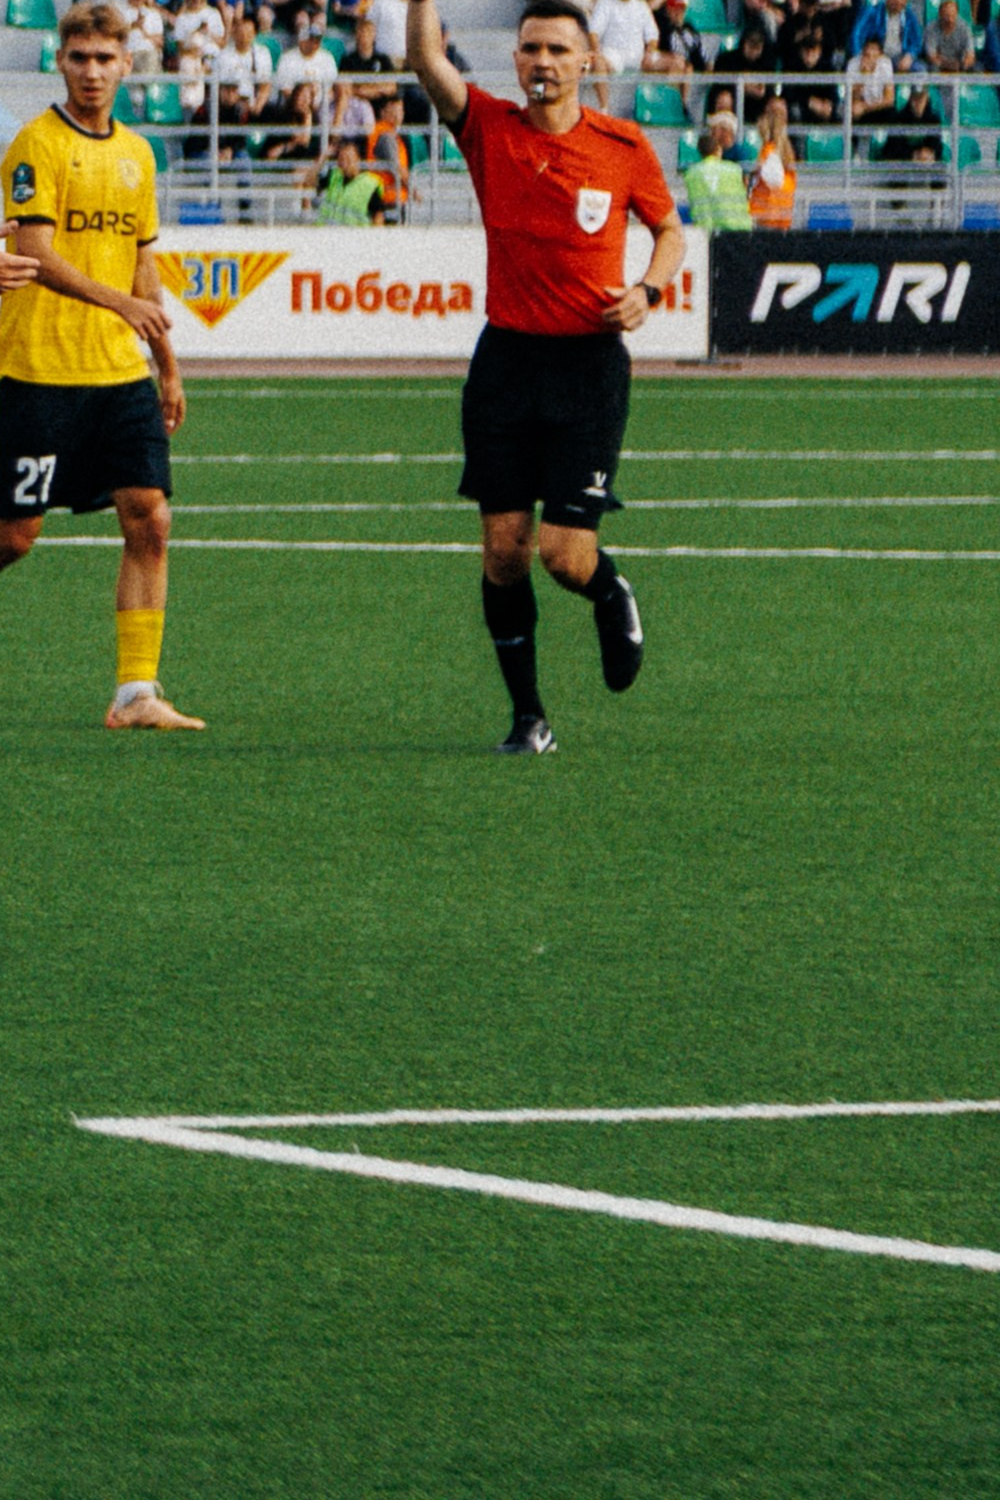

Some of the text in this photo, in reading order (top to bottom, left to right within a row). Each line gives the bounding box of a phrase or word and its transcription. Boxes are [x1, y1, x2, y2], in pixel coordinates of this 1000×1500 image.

[65, 209, 137, 235] DARS
[290, 269, 474, 318] Победа
[750, 261, 972, 324] PARI
[14, 454, 57, 505] 27
